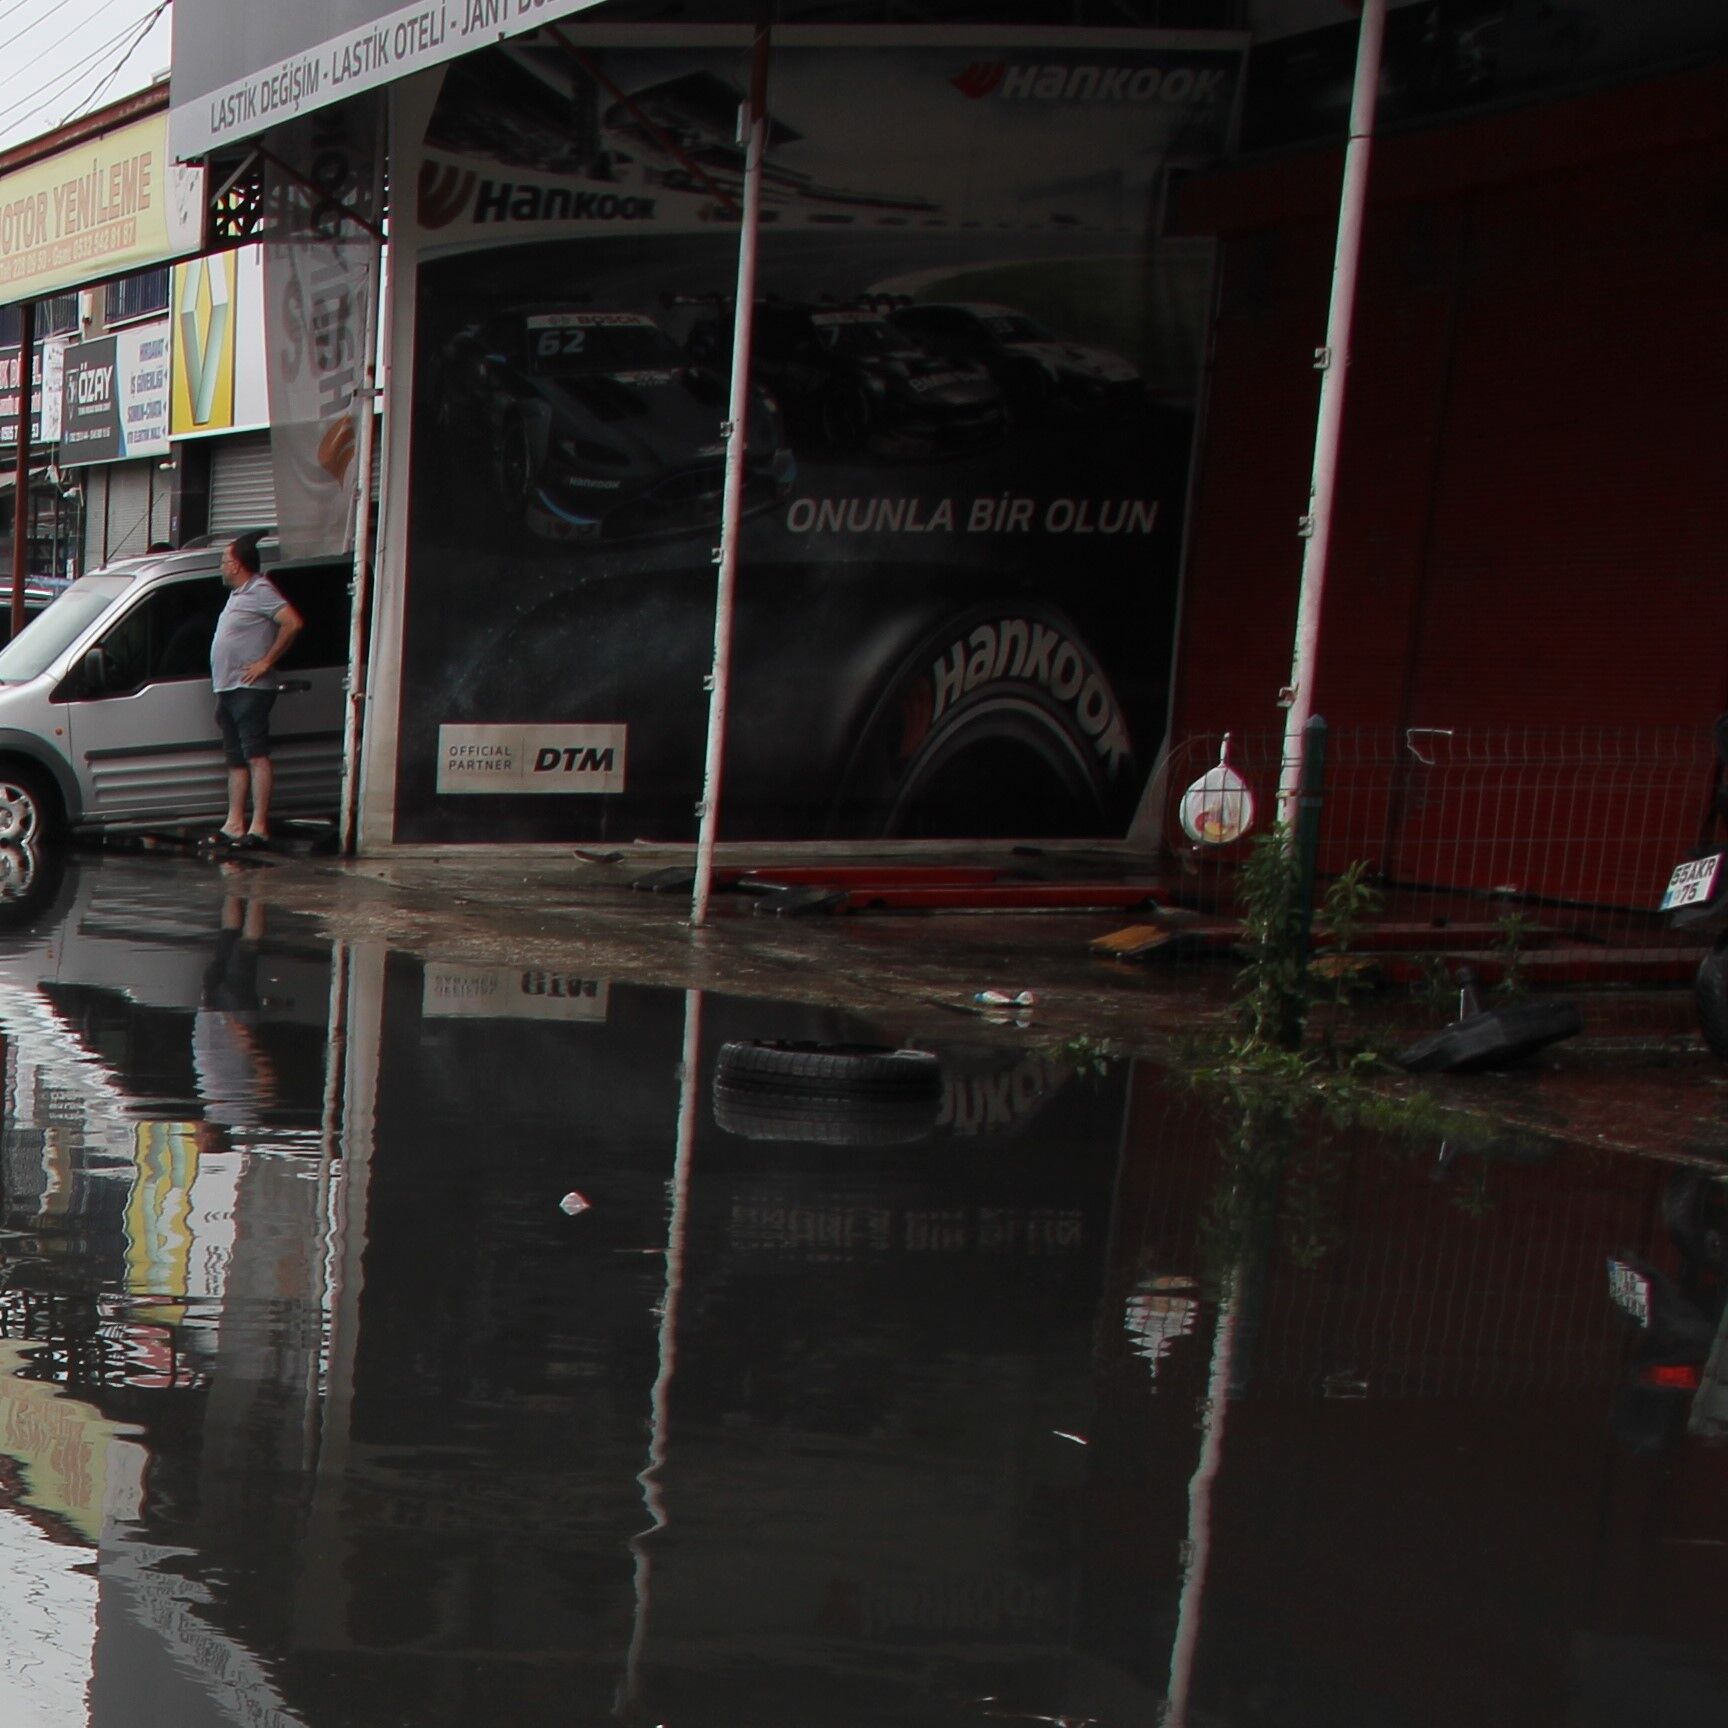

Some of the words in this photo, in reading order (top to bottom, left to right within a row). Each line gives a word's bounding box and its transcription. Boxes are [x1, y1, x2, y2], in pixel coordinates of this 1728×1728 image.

[210, 82, 257, 134] LASTİK
[261, 56, 320, 112] DEĞİŞİM
[332, 26, 390, 85] LASTİK
[394, 2, 446, 61] OTELİ
[53, 151, 152, 239] YENİLEME
[536, 329, 586, 356] 62
[78, 361, 113, 404] ÖZAY
[786, 498, 956, 534] ONUNLA
[966, 490, 1033, 534] BİR
[1045, 498, 1161, 534] OLUN
[449, 745, 512, 757] OFFICIAL
[449, 759, 512, 771] PARTNER
[534, 748, 614, 773] DTM
